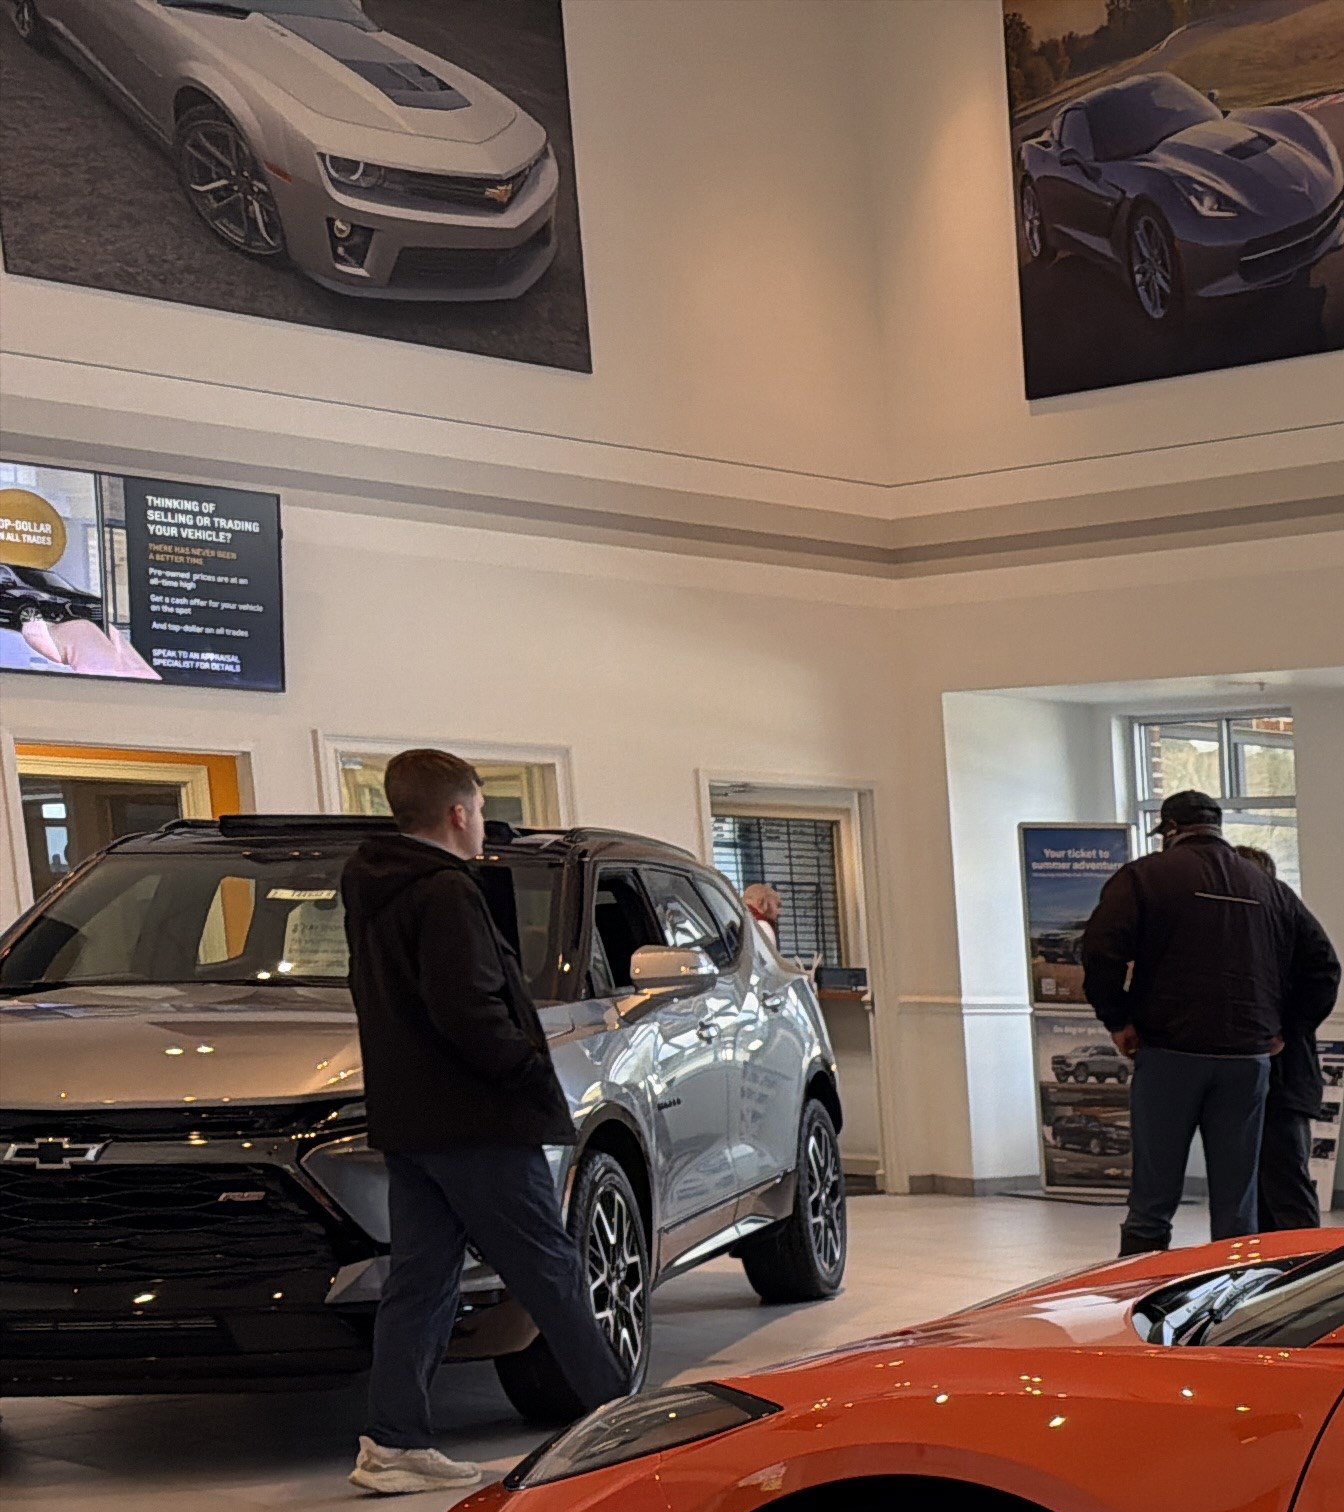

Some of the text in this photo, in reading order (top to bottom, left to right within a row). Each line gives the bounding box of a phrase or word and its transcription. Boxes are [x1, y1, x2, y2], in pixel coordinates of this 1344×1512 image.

[145, 495, 217, 514] THINKING OF
[0, 518, 52, 535] OP-DOLLAR
[147, 510, 260, 533] SELLING OR TRADING
[147, 524, 232, 543] YOUR VEHICLE?
